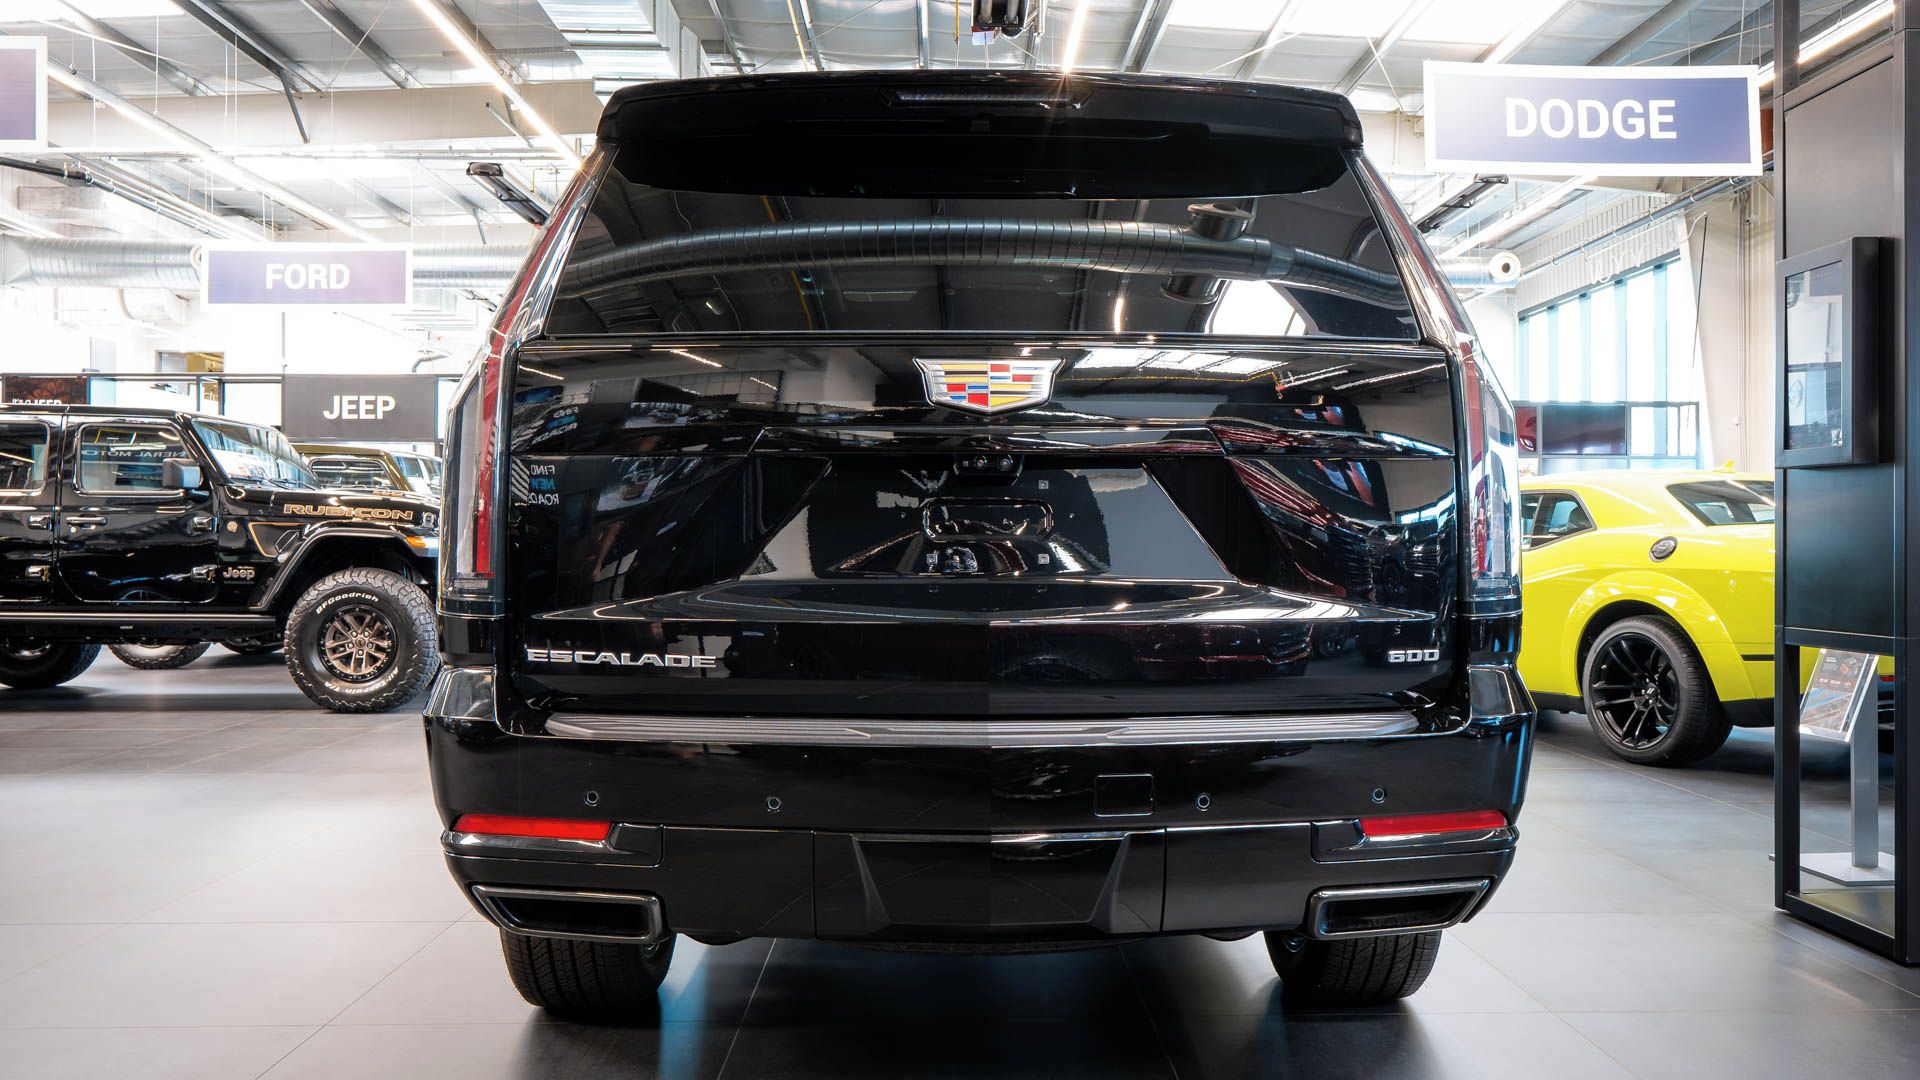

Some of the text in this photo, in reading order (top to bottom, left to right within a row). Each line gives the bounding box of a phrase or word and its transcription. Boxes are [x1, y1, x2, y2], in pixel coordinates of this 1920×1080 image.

[1505, 97, 1677, 139] DODGE
[266, 263, 350, 289] FORD
[323, 395, 396, 420] JEEP
[283, 504, 414, 520] RUBICON
[223, 567, 256, 580] Jeep
[315, 592, 379, 614] BFGoodrich
[526, 649, 717, 668] ESCALADE
[1387, 649, 1440, 663] 600
